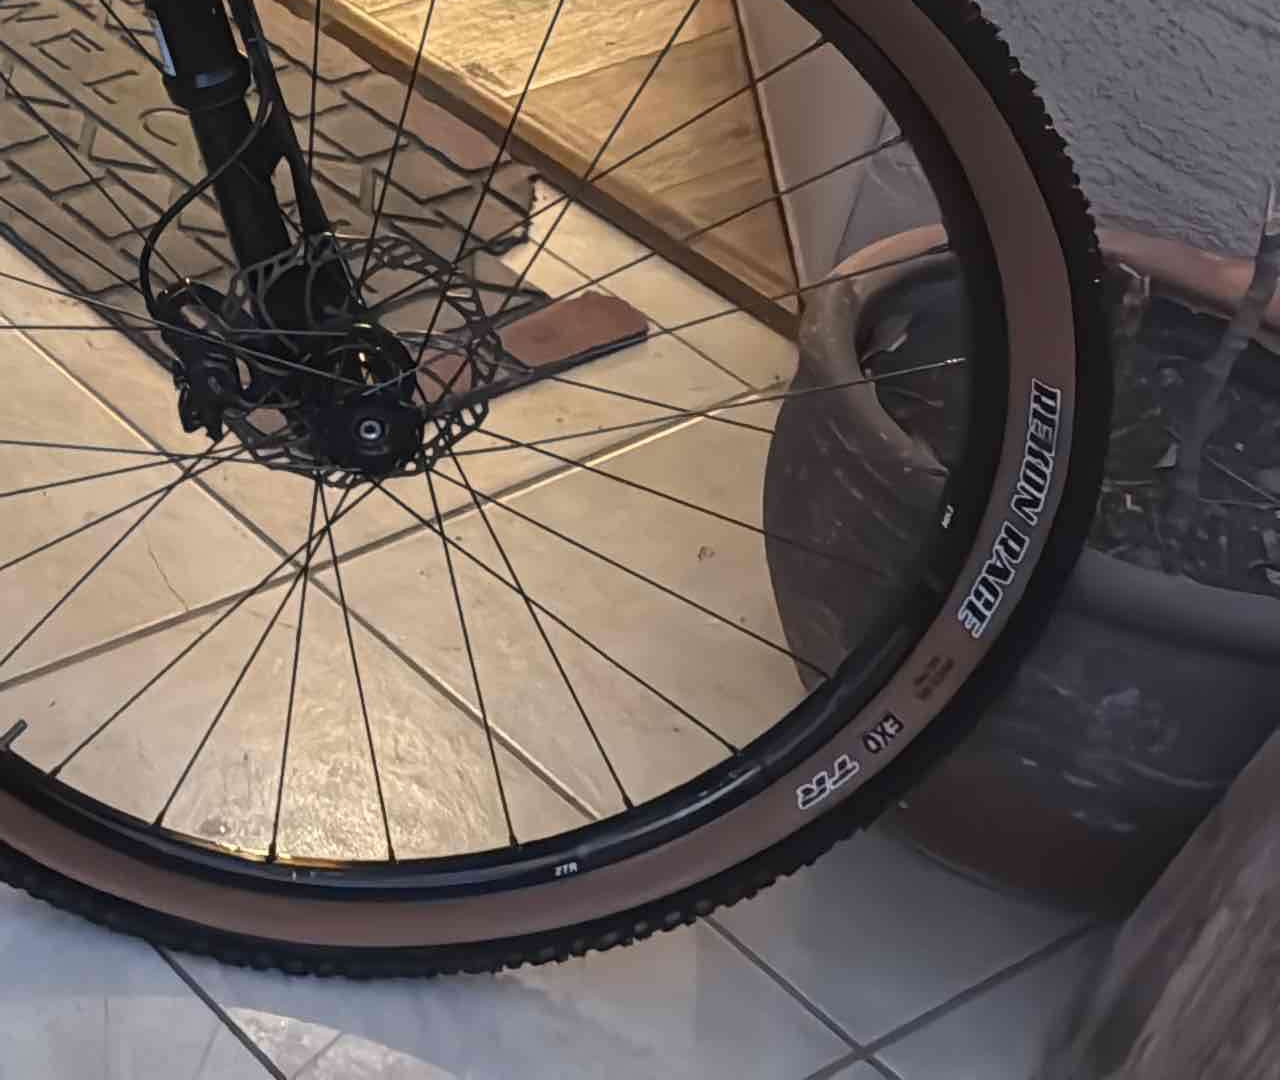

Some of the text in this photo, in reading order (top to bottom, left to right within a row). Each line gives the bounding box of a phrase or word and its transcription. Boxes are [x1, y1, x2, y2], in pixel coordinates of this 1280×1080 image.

[957, 376, 1062, 639] REKON RACE
[862, 713, 906, 755] EXO
[796, 752, 861, 810] TR
